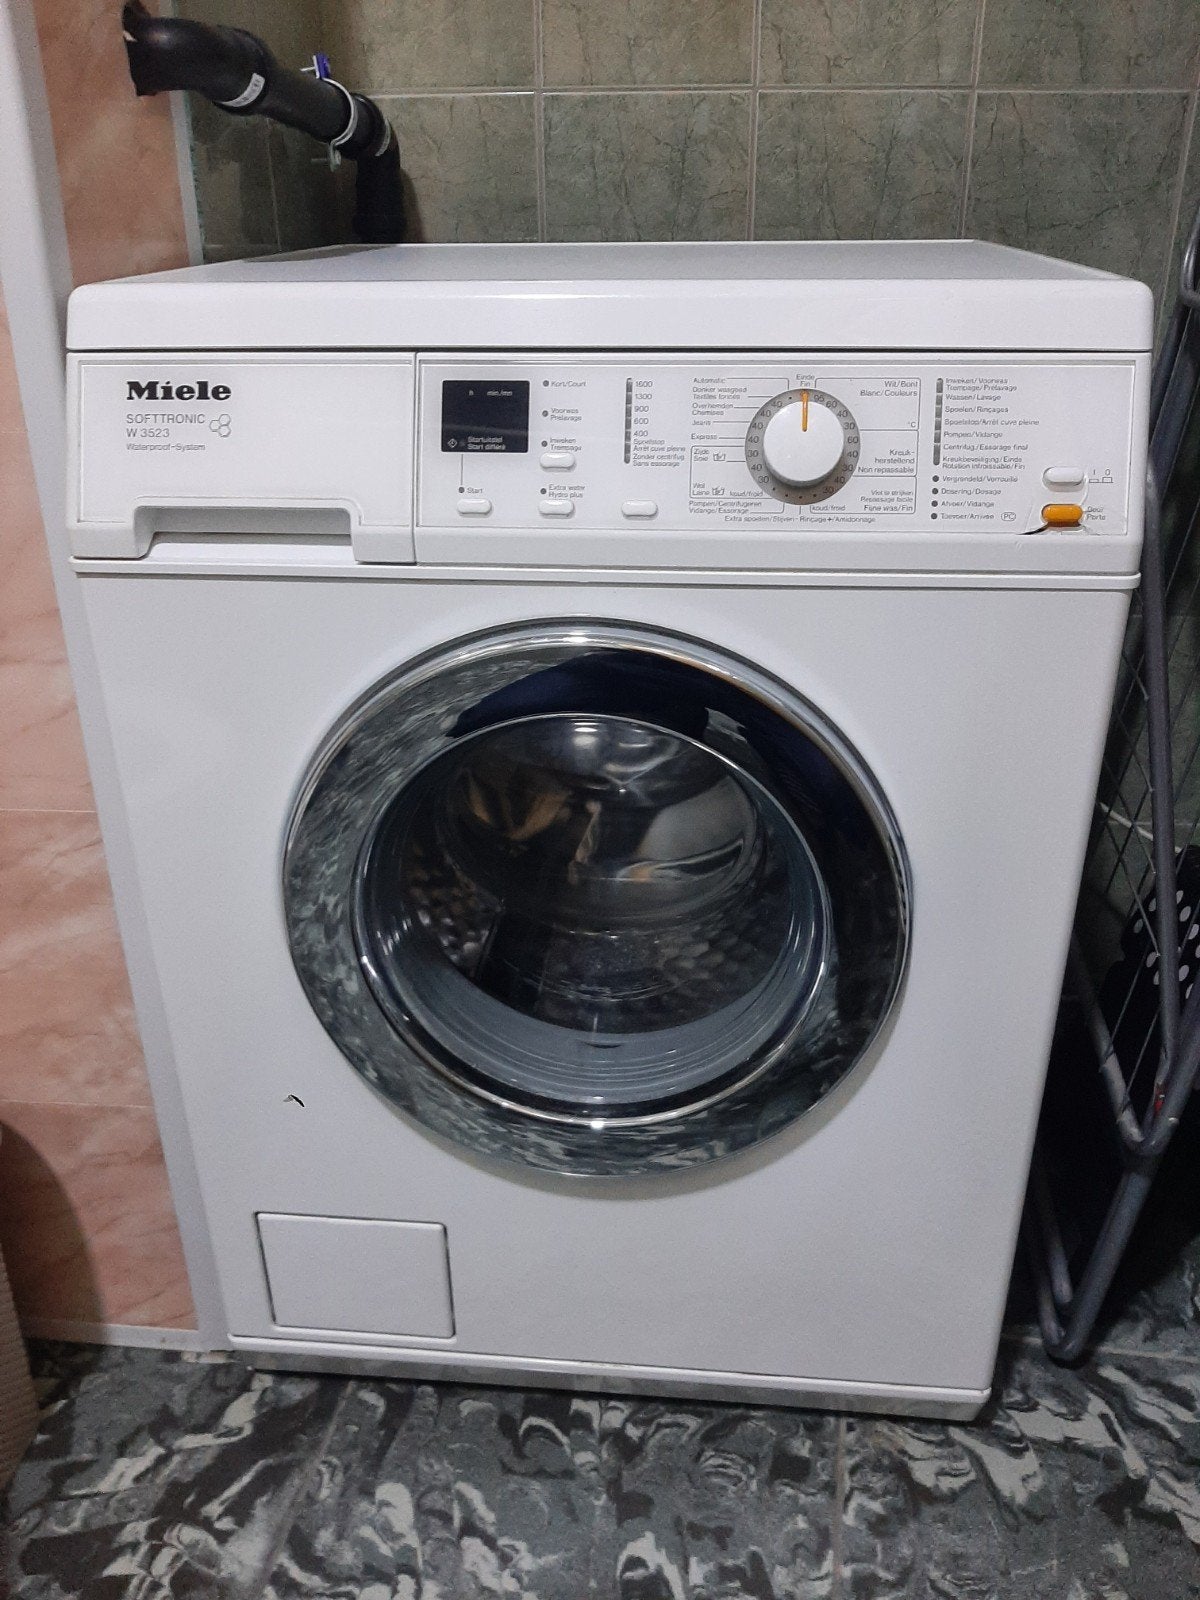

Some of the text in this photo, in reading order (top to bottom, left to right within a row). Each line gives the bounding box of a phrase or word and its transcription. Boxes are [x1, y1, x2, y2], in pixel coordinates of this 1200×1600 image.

[126, 381, 232, 401] Miele
[814, 395, 825, 403] 95
[826, 401, 838, 409] 60
[760, 410, 772, 418] 40
[837, 410, 848, 418] 40
[126, 413, 206, 424] SOFTTRONIC
[752, 422, 764, 430] 40
[126, 428, 170, 438] W 3523
[748, 436, 760, 444] 40
[848, 436, 859, 444] 60
[126, 443, 206, 452] Waterproof-System
[748, 450, 759, 458] 30
[751, 464, 763, 472] 40
[843, 464, 854, 472] 30
[758, 476, 770, 484] 30
[835, 477, 845, 485] 40
